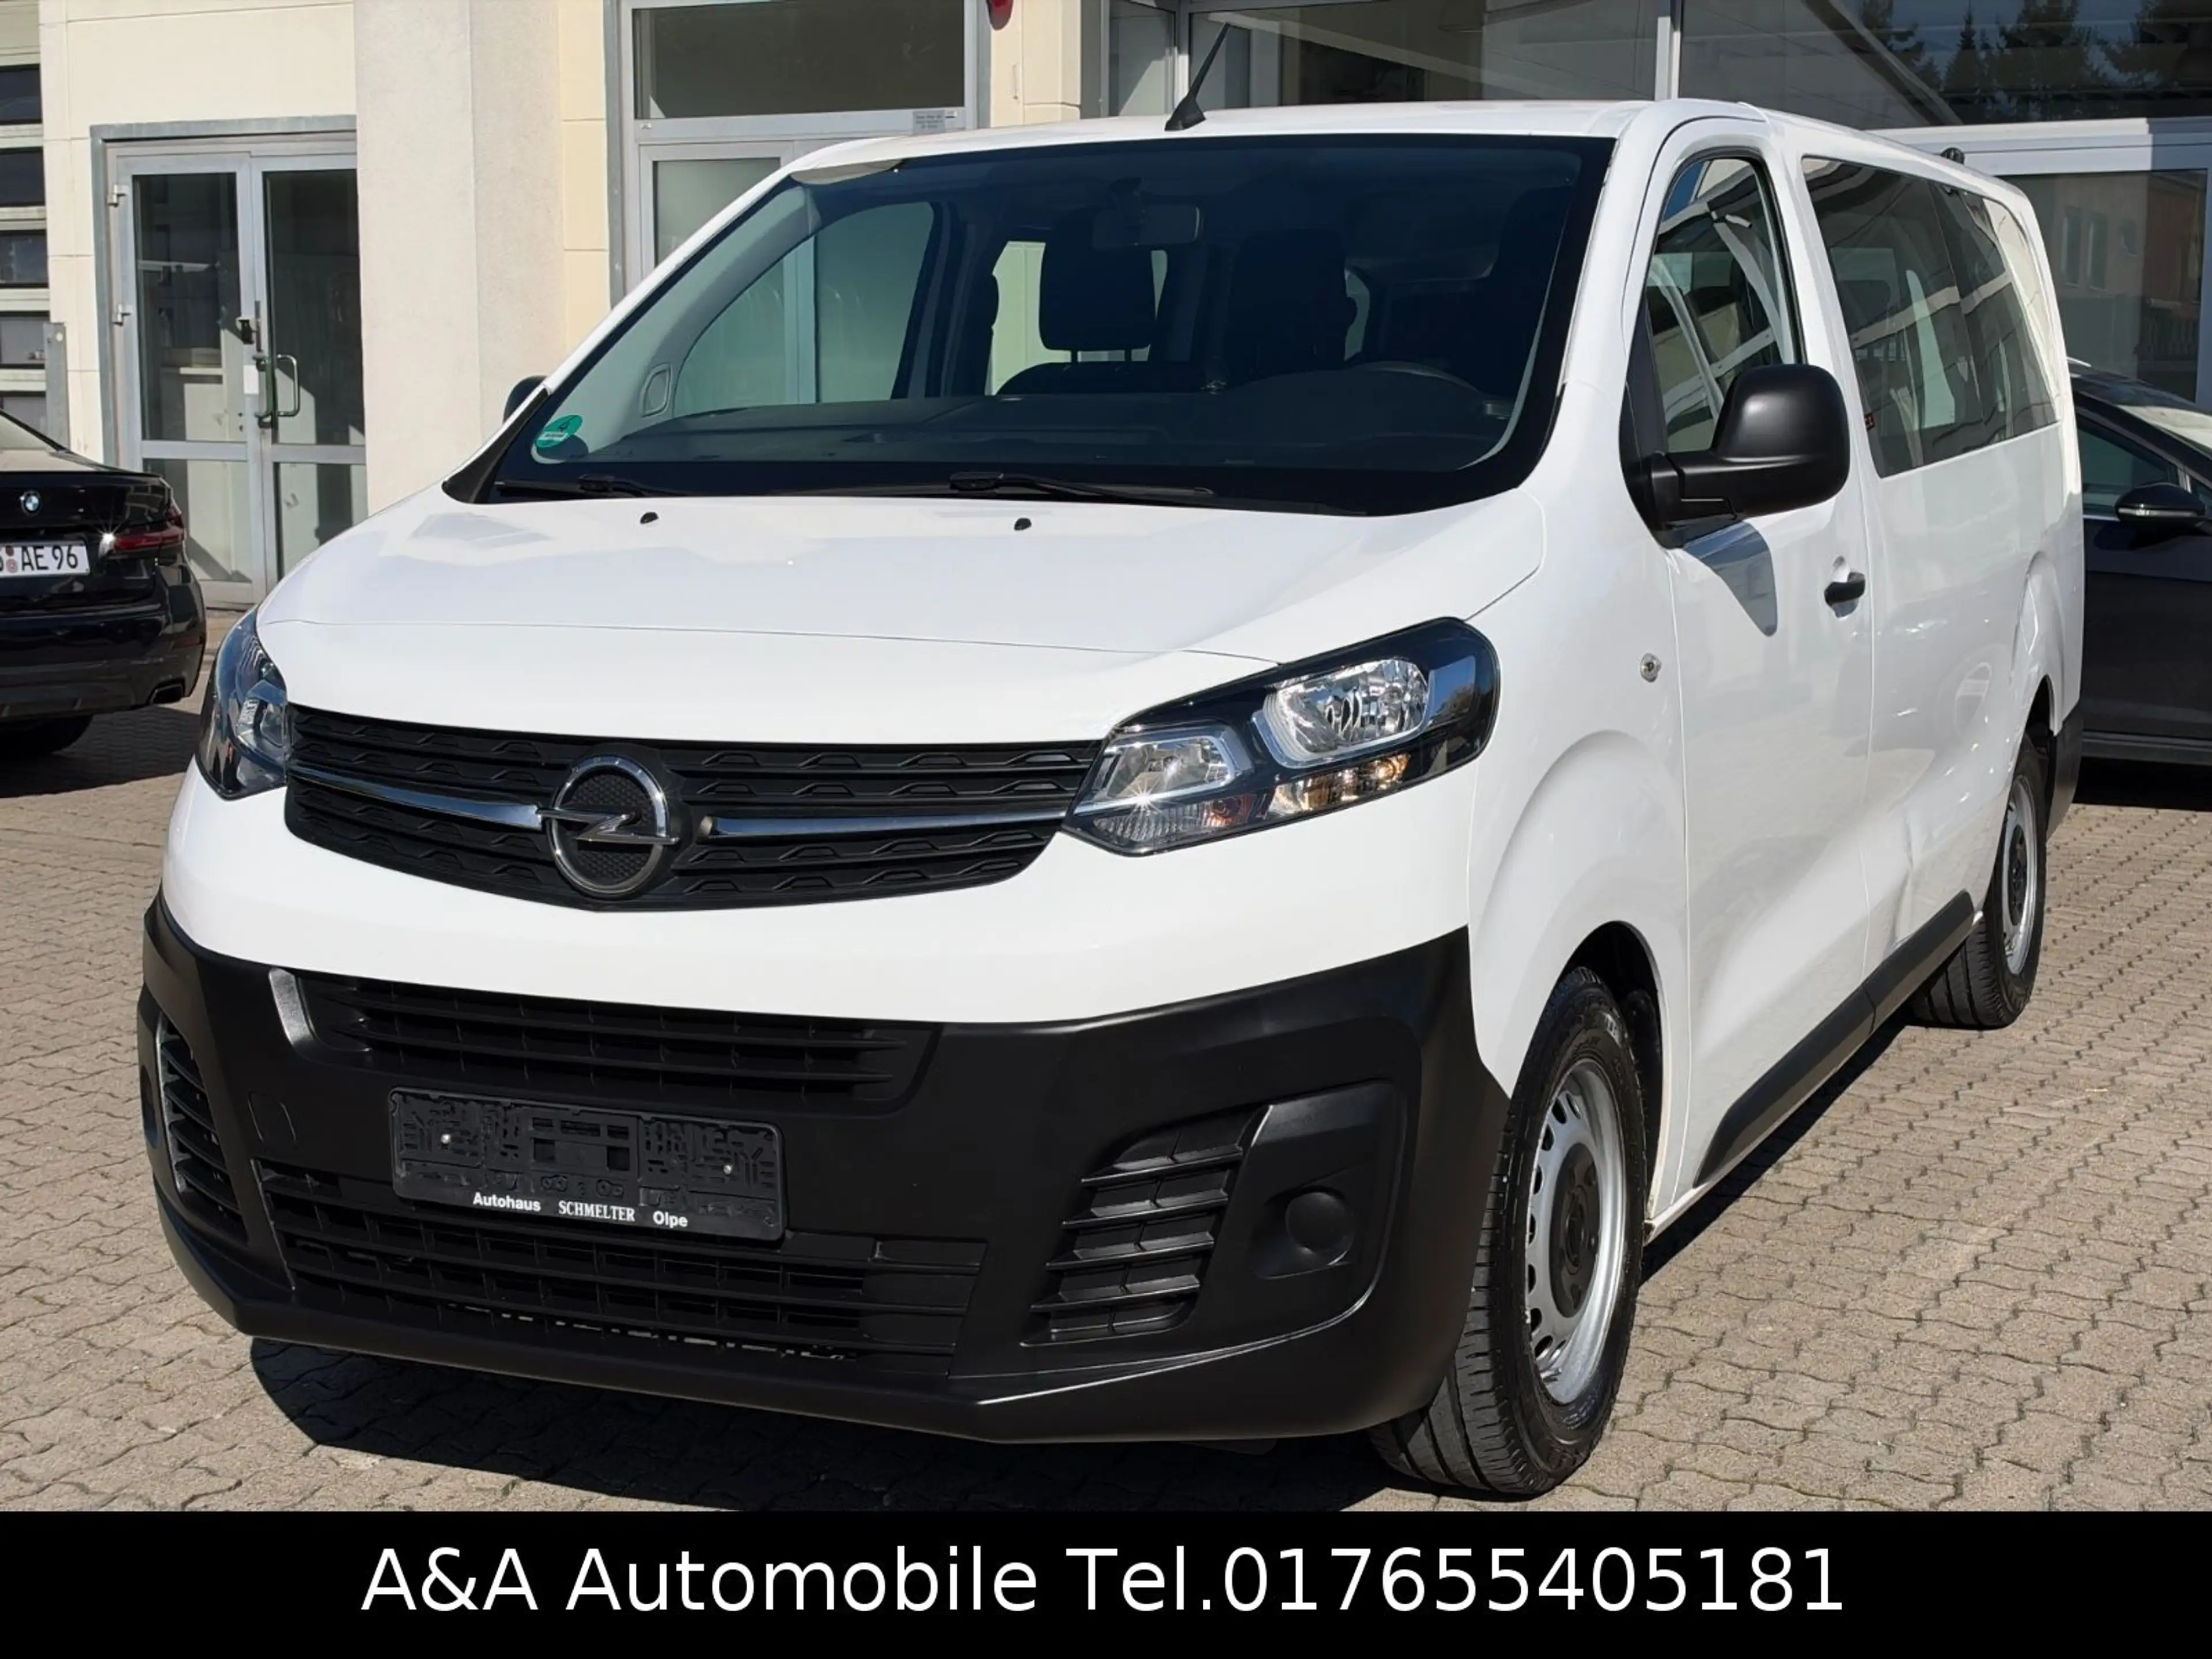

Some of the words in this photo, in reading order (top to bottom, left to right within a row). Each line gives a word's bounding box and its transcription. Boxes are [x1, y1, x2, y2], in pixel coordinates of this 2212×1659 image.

[21, 545, 49, 571] AE
[52, 544, 78, 570] 96
[472, 1191, 541, 1212] Autohaus
[558, 1200, 635, 1222] SCHMELTER
[652, 1210, 688, 1229] Olpe
